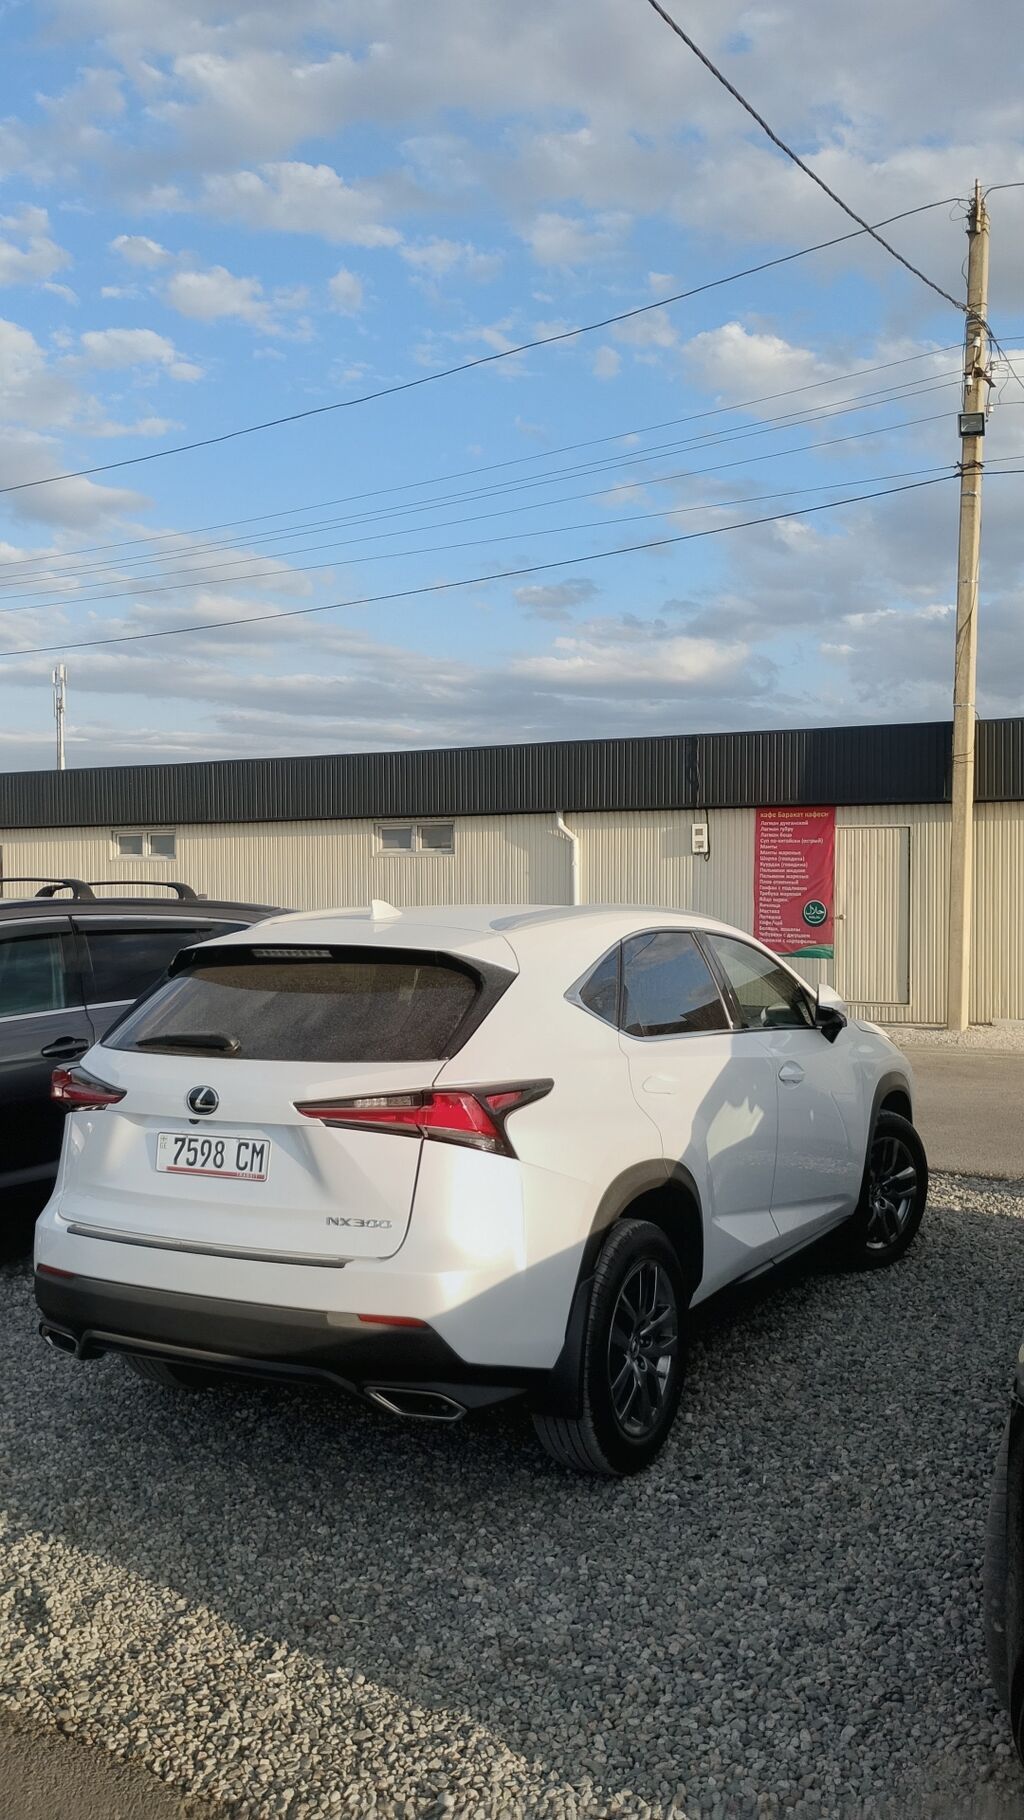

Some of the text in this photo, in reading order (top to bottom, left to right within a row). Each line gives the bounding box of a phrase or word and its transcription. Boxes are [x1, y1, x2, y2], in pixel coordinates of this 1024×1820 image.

[173, 1137, 265, 1172] 7598 CM
[326, 1217, 392, 1228] NX300
